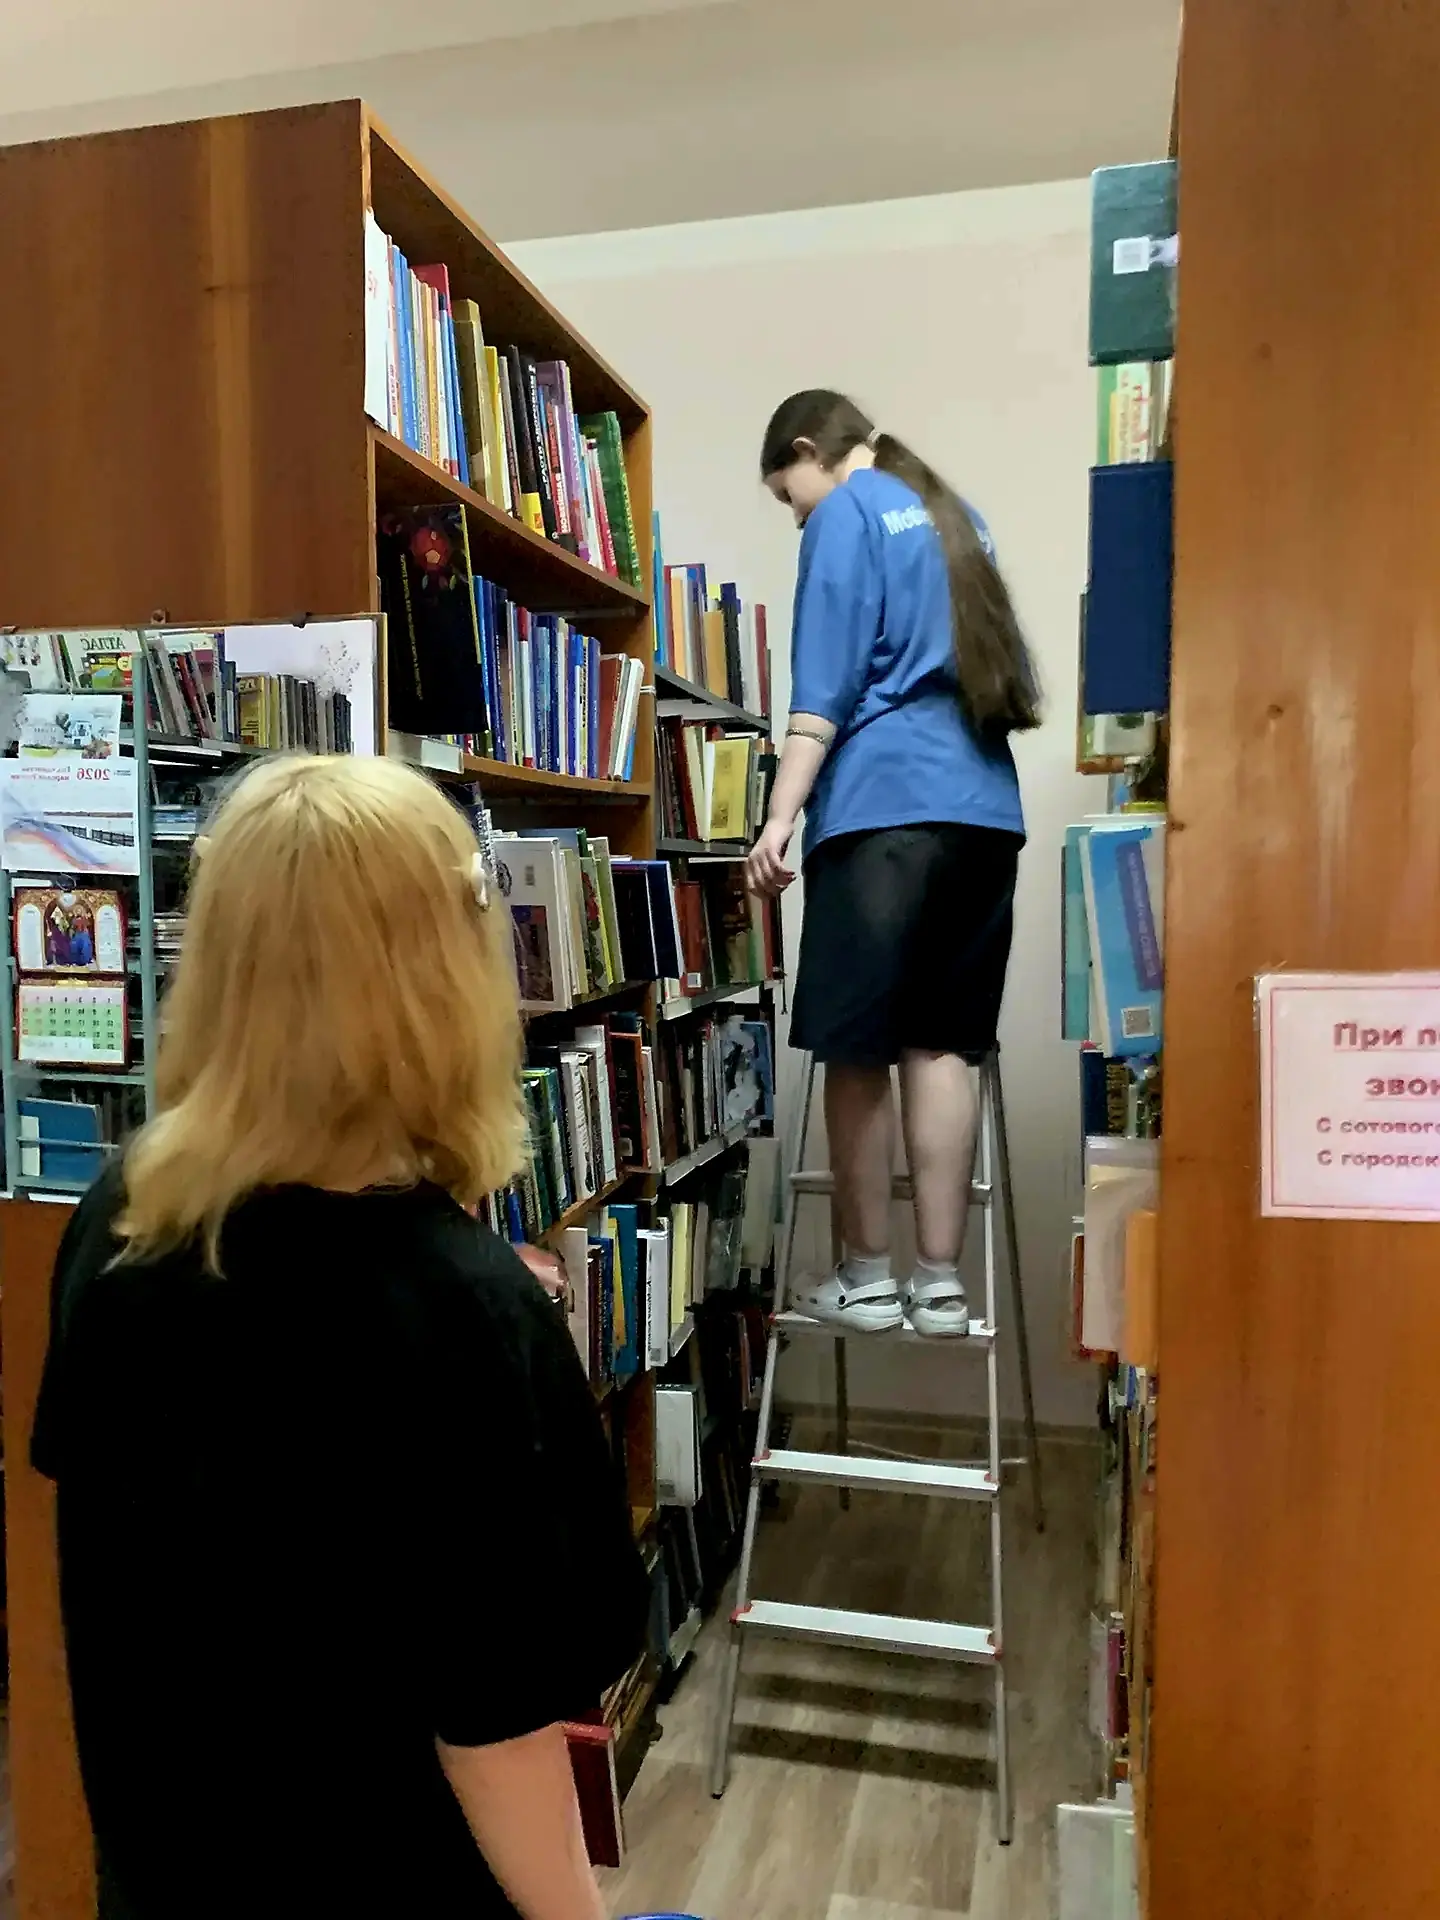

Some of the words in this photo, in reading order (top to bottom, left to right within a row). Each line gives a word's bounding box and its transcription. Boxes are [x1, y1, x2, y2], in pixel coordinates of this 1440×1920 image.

[1333, 1022, 1404, 1050] При
[1418, 1028, 1440, 1046] п
[1316, 1116, 1332, 1133] С
[1317, 1149, 1333, 1166] С
